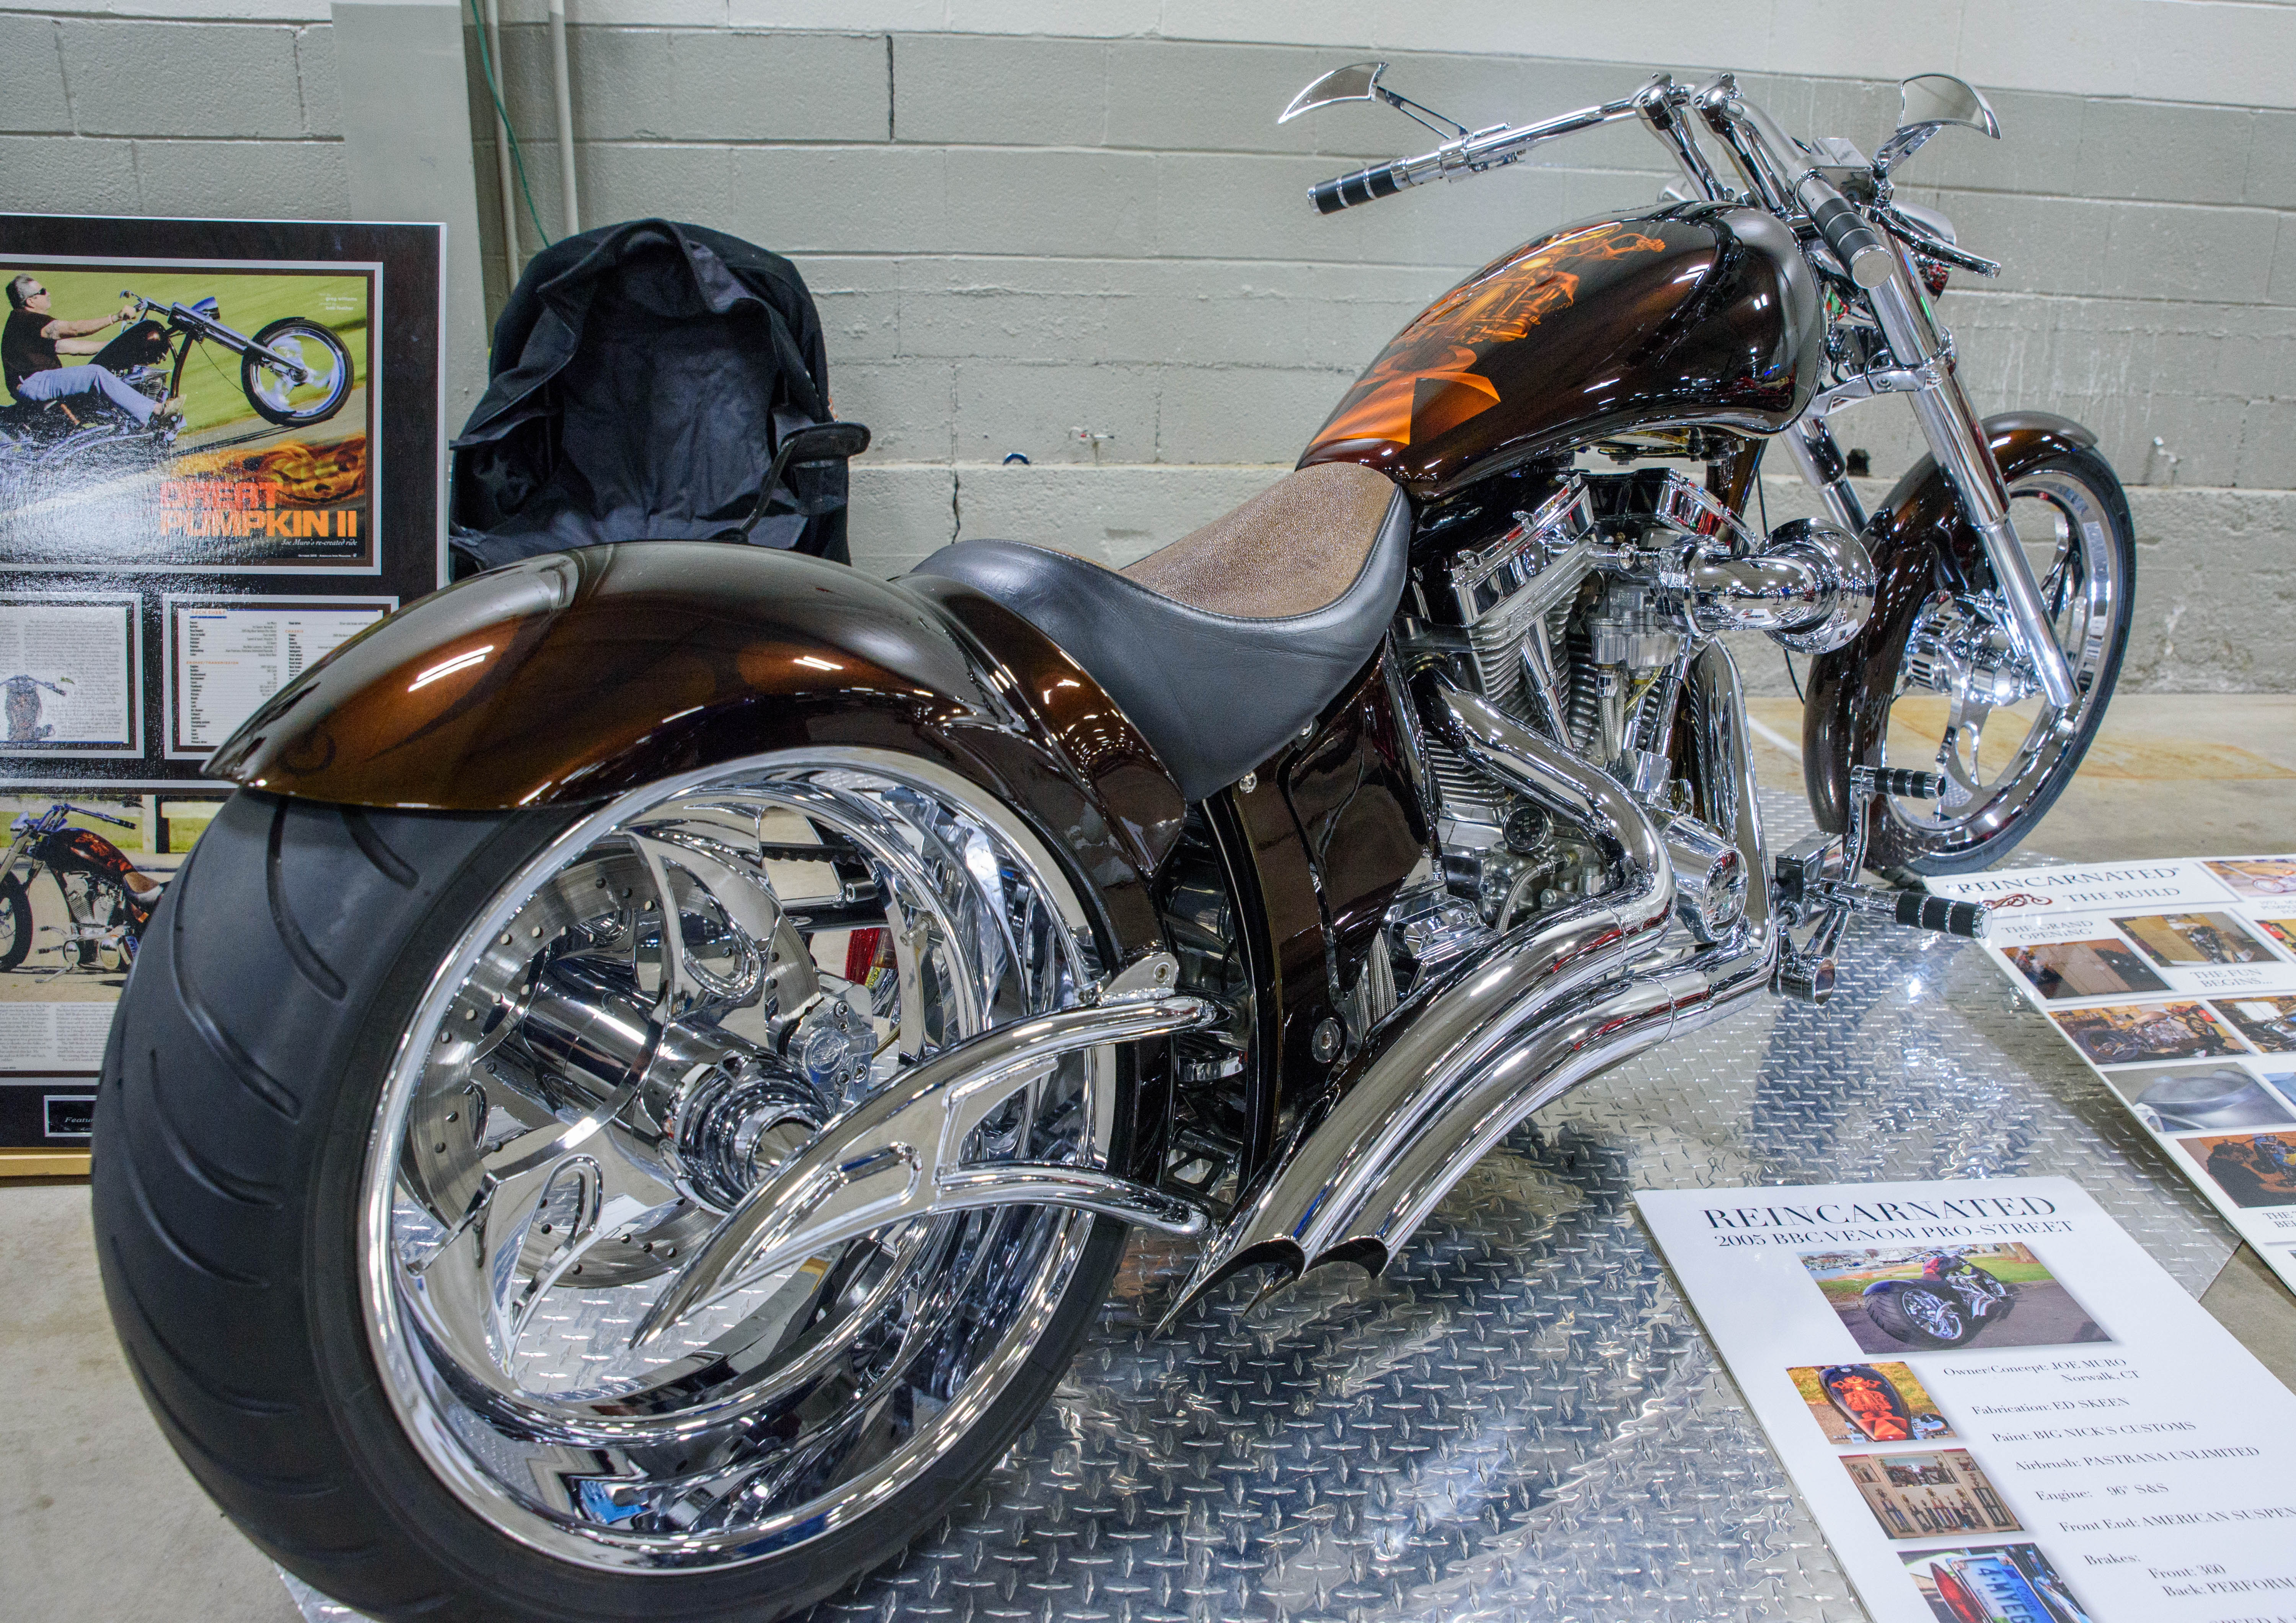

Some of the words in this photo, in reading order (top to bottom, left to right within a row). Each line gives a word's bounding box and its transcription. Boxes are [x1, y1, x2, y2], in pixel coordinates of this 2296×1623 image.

[160, 510, 329, 537] PUMPKIN
[337, 510, 357, 537] II
[2063, 893, 2112, 902] THE
[2114, 888, 2180, 899] BUILD
[2001, 925, 2034, 934] THE
[2036, 920, 2093, 931] GRAND
[2019, 928, 2092, 940] OPENING
[2190, 970, 2227, 979] THE
[2227, 968, 2262, 977] FUN
[2200, 978, 2273, 988] BEGINS...
[1699, 1196, 2056, 1228] REINCARNATED
[1714, 1234, 1766, 1246] 2005
[1771, 1231, 1823, 1244] BBC
[1823, 1227, 1918, 1242] VENOM
[1919, 1220, 2075, 1238] PRO-STREET
[1944, 1363, 2049, 1376] Owner/Concept:
[2050, 1360, 2082, 1370] JOE
[2080, 1358, 2126, 1369] MURO
[2060, 1371, 2121, 1382] Norwalk,
[2120, 1370, 2141, 1379] CT
[1971, 1403, 2051, 1415] Fabrication:
[2051, 1400, 2075, 1410] ED
[2078, 1397, 2131, 1409] SKEEN
[1990, 1432, 2032, 1442] Paint:
[2032, 1430, 2062, 1440] BIG
[2062, 1426, 2117, 1438] NICK'S
[2120, 1421, 2197, 1435] CUSTOMS
[2016, 1459, 2082, 1471] Airbrush:
[2081, 1452, 2168, 1466] PASTRANA
[2168, 1447, 2260, 1461] UNLIMITED
[2034, 1489, 2093, 1502] Engine:
[2135, 1483, 2169, 1494] S&S
[2059, 1520, 2099, 1532] Front
[2102, 1517, 2140, 1529] End:
[2142, 1510, 2230, 1527] AMERICAN
[2082, 1553, 2141, 1566] Brakes:
[2146, 1567, 2197, 1579] Front:
[2195, 1563, 2227, 1575] 360
[2161, 1584, 2207, 1597] Back:
[2205, 1576, 2296, 1594] PERFORM
